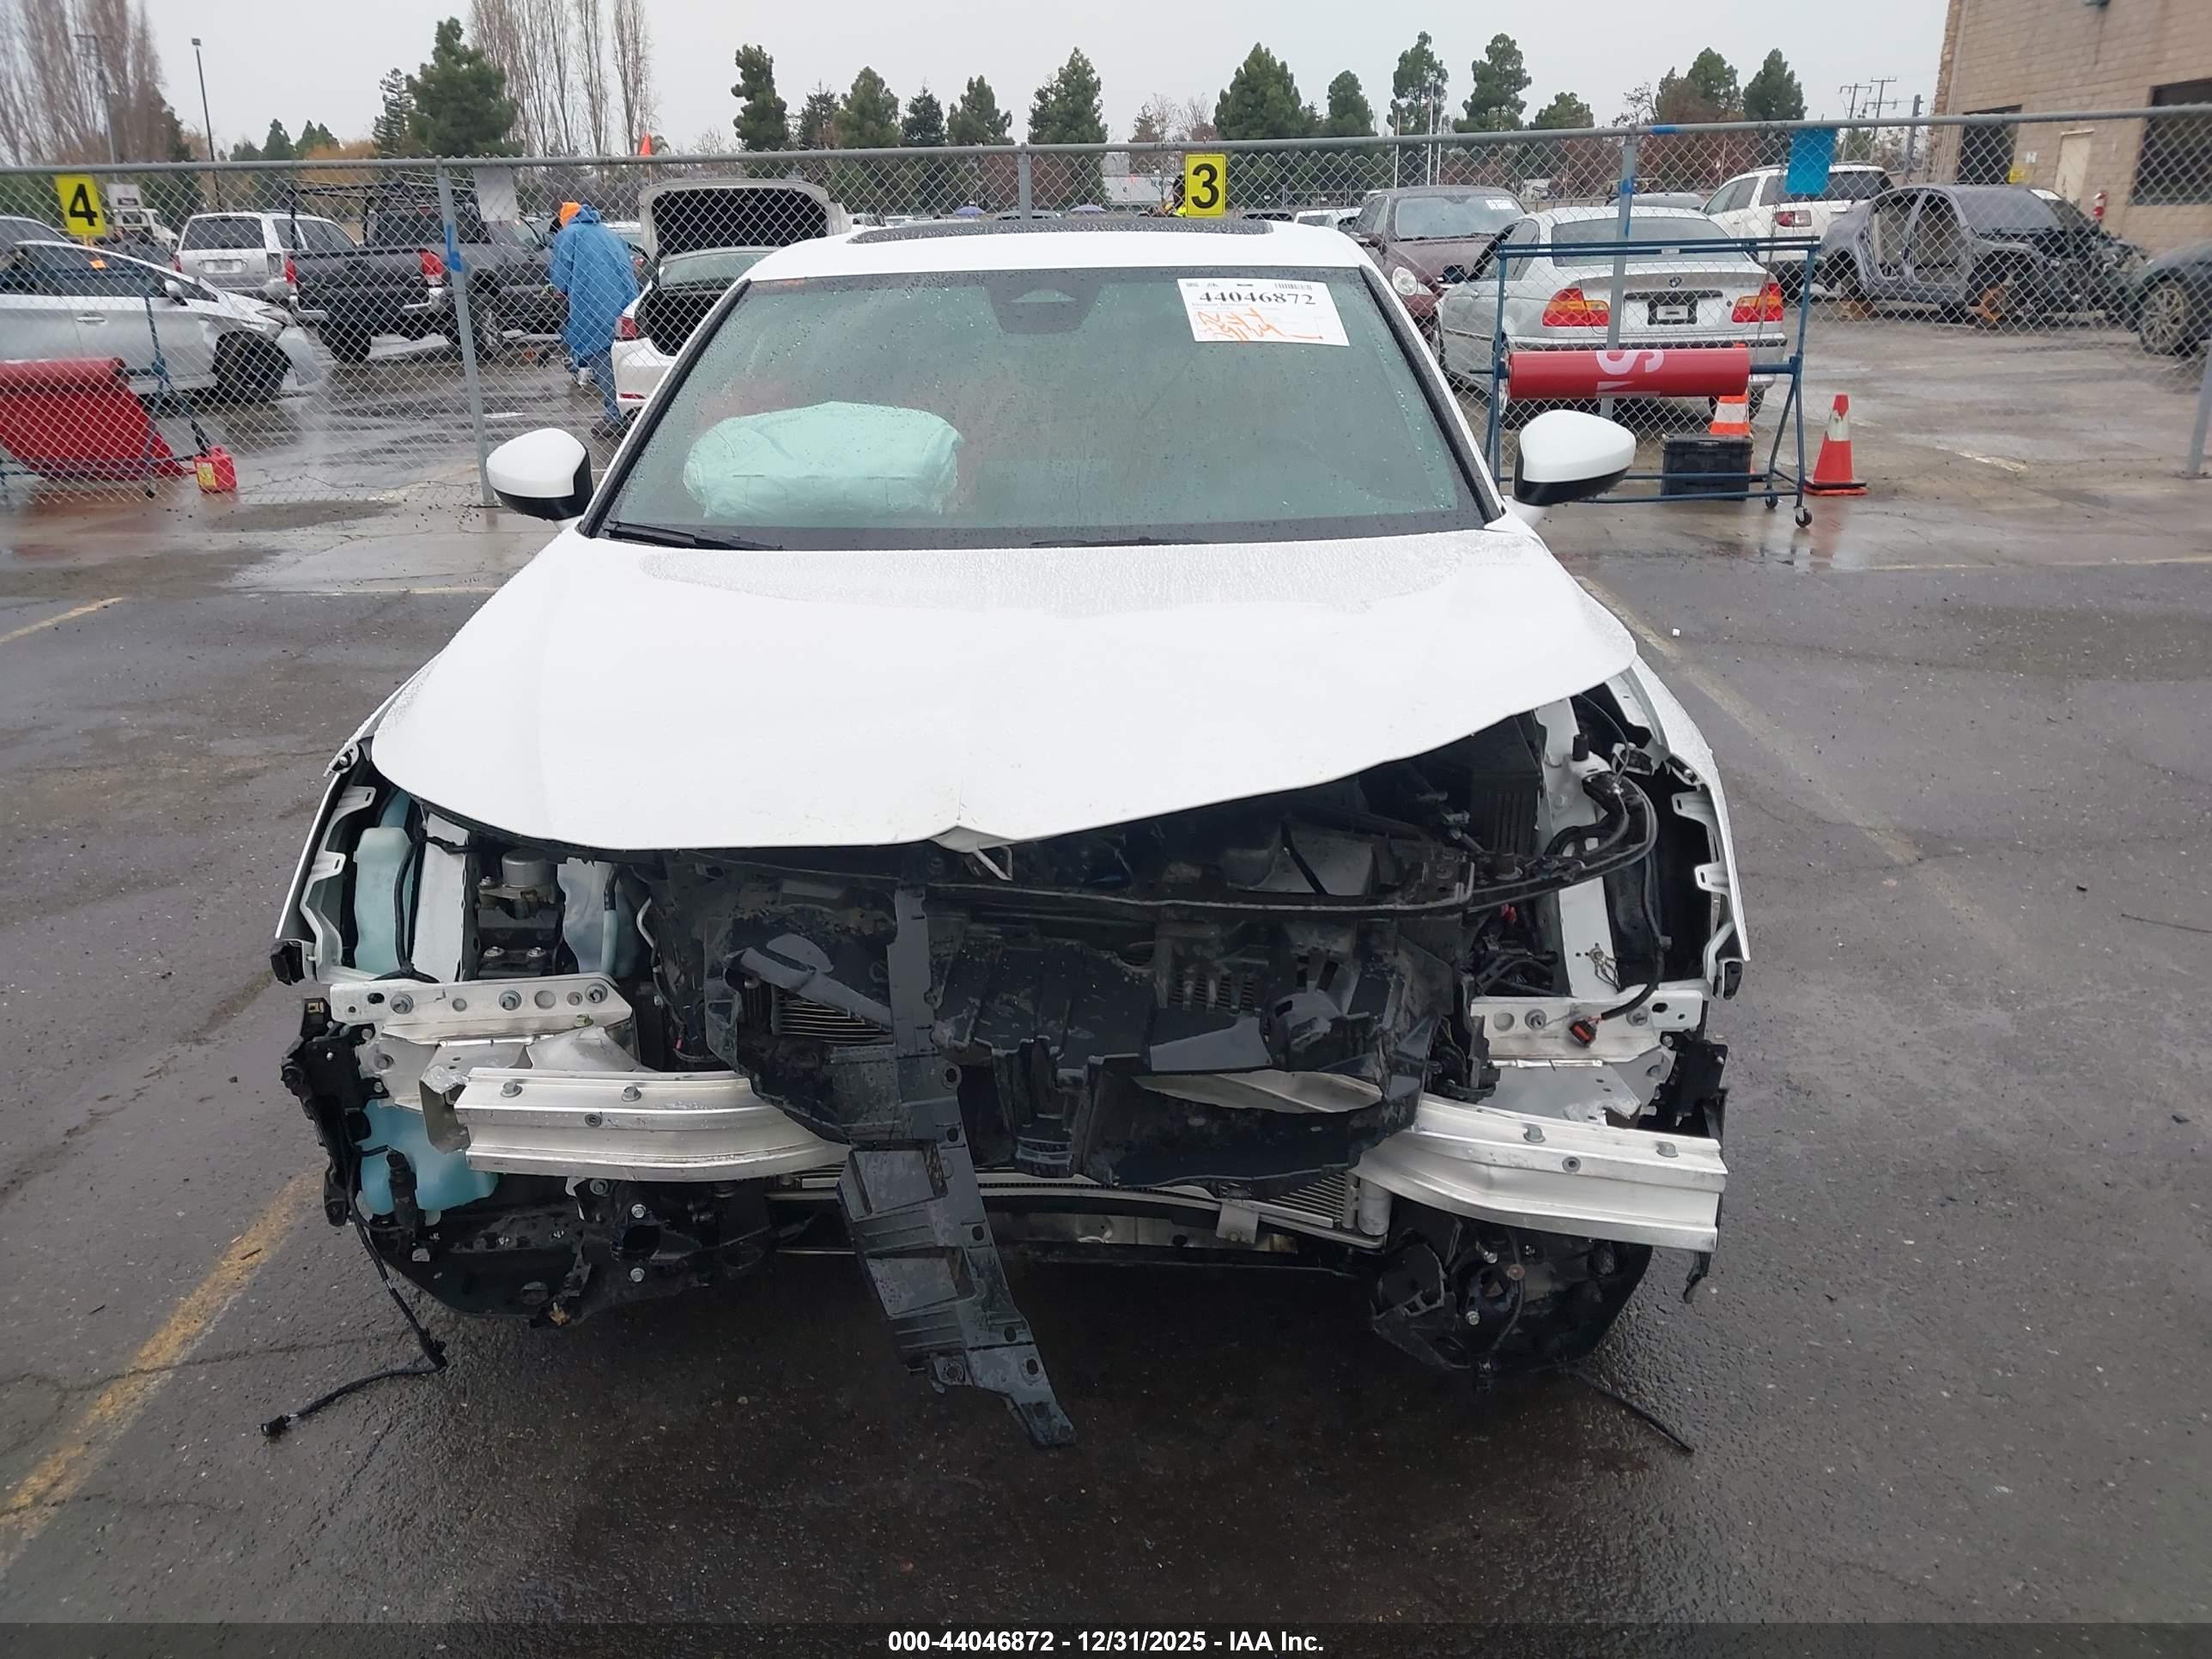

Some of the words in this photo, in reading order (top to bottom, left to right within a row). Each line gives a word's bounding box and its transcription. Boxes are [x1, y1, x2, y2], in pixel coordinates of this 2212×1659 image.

[69, 183, 98, 227] 4
[1191, 162, 1219, 210] 3
[1200, 291, 1316, 306] 44046872
